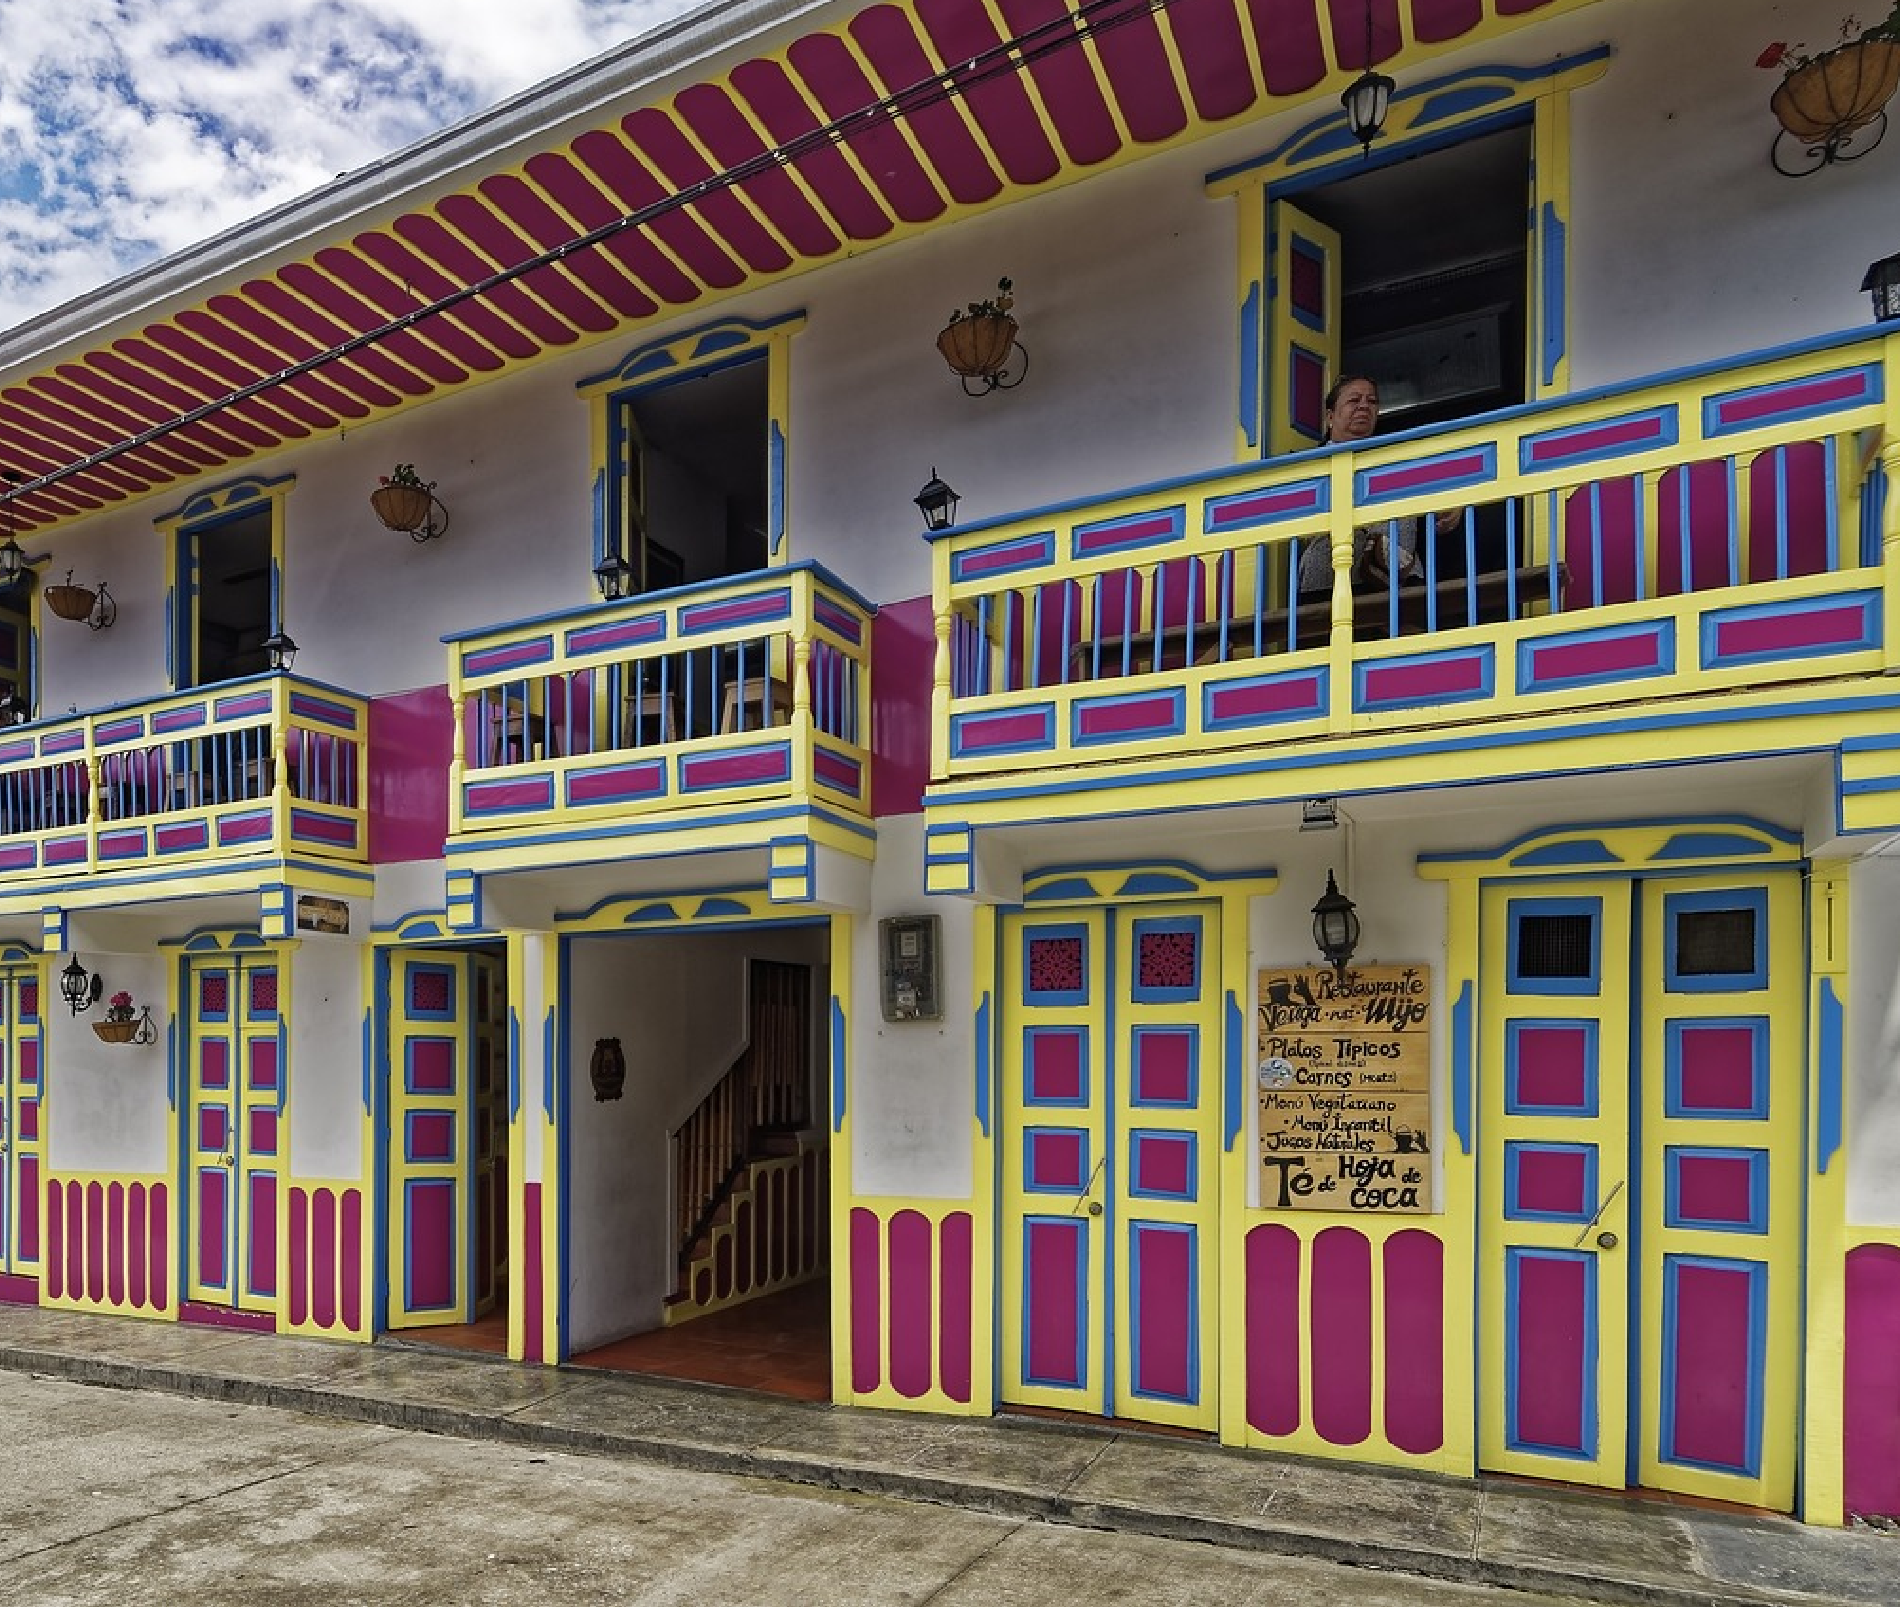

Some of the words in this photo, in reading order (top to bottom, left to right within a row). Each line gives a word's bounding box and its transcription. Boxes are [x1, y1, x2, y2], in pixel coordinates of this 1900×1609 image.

[1315, 969, 1424, 1000] Restaurante
[1363, 996, 1430, 1033] Mijo
[1267, 1037, 1323, 1059] Platos
[1296, 1067, 1353, 1088] Carnes
[1263, 1155, 1315, 1206] Té
[1317, 1174, 1337, 1192] de
[1338, 1155, 1396, 1187] Hoja
[1401, 1167, 1423, 1184] de
